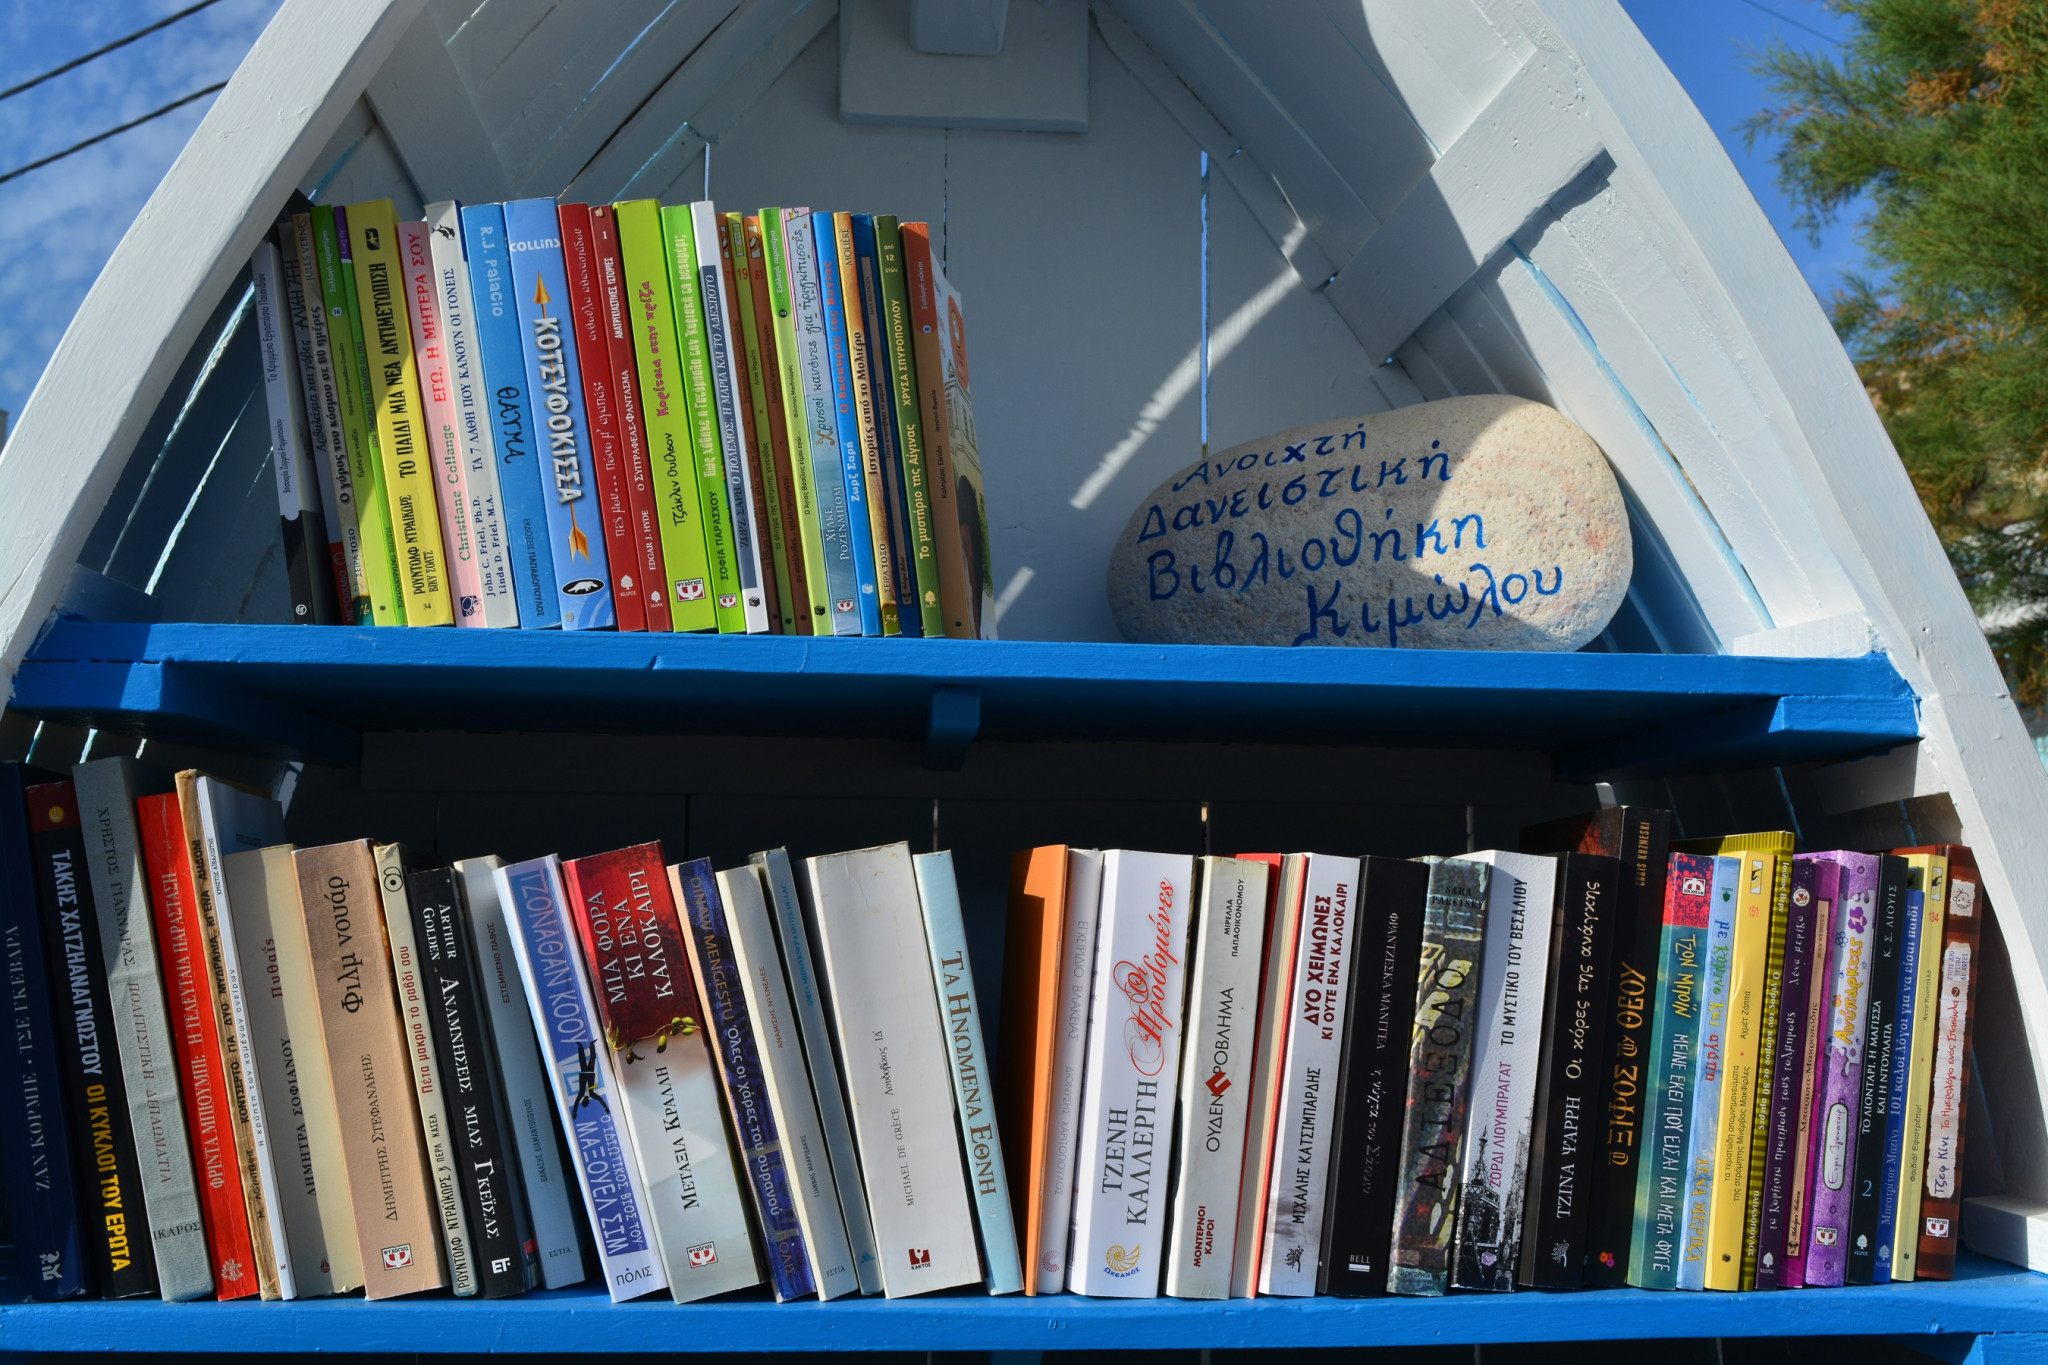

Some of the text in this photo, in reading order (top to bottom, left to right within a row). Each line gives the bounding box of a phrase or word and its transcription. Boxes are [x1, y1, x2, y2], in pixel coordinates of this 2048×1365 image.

[296, 222, 315, 280] JULES VERNE
[444, 268, 459, 309] ΓΟΝΕΙΣ
[369, 262, 416, 478] ΤΟ ΠΑΙΔΙ ΜΙΑ ΝΕΑ ΑΝΤΙΜΕΤΩΠΙΣΗ
[408, 233, 446, 402] ΕΓΩ, Η ΜΗΤΕΡΑ ΣΟΥ
[450, 313, 461, 326] ΟΙ
[453, 330, 469, 377] ΚΑΝΟΥΝ
[639, 281, 670, 416] Κορίτσια στην πρίζα
[891, 299, 911, 405] ΧΡΥΣΑ ΣΠΥΡΟΠΟΥΛΟΥ
[311, 306, 350, 503] Ο γύρος του κόσμου σε 80 ημέρες
[460, 384, 473, 407] ΠΟΥ
[465, 411, 479, 442] ΛΑΘΗ
[533, 316, 582, 503] ΚΟΤΣΥΦΟΚΙΣΣΑ
[703, 273, 742, 486] Ο ΠΟΛΕΜΟΣ. Η ΜΑΡΙΑ ΚΑΙ ΤΟ ΑΔΕΣΠΟΤΟ
[855, 330, 880, 476] Ιστορίες από το Μολιέρο
[443, 424, 470, 561] Christiane Collange
[472, 457, 482, 471] ΤΑ
[663, 432, 687, 526] Τζάκλιν Ουίλσον
[906, 424, 930, 559] Το μυστήριο της Αίγινας
[1136, 439, 1453, 544] Δανειστική
[1172, 423, 1368, 492] Ανοιχτή
[423, 550, 438, 592] ΒΙΚΥ ΣΟΛΤΣ
[523, 518, 544, 616] ΕΚΔΟΣΕΙΣ ΠΑΠΑΔΟΠΟΥΛΟΣ
[641, 510, 650, 532] HYDE
[646, 542, 656, 570] EDGAR
[709, 491, 728, 580] ΣΟΦΙΑ ΠΑΡΑΣΧΟΥ
[1147, 508, 1487, 601] Βιβλιοθήκη
[1290, 563, 1563, 647] Κιμώλου
[52, 849, 102, 1074] ΤΑΚΗΣ ΧΑΤΖΗΑΝΑΓΝΩΣΤΟΥ
[324, 876, 363, 1013] Φιλμ νουάρ
[422, 907, 439, 959] GOLDEN
[438, 904, 456, 958] ARTHUR
[520, 868, 588, 1044] ΤΖΟΝΑΘΑΝ ΚΟΟΥ
[587, 890, 627, 1003] ΜΙΑ ΦΟΡΑ
[613, 898, 645, 979] ΚΙ ΕΝΑ
[628, 869, 674, 999] ΚΑΛΟΚΑΙΡΙ
[1224, 899, 1233, 935] ΜΙΡΕΛΛΑ
[1232, 879, 1244, 957] ΠΑΠΑΟΙΚΟΝΟΜΟΥ
[1304, 895, 1330, 1025] ΔΥΟ ΧΕΙΜΩΝΕΣ
[1321, 883, 1347, 1039] ΚΙ ΟΥΤΕ ΕΝΑ ΚΑΛΟΚΑΙΡΙ
[1501, 878, 1526, 1044] ΤΟ ΜΥΣΤΙΚΟ ΤΟΥ ΒΕΣΑΛΙΟΥ
[1883, 885, 1897, 957] Κ. Σ. ΛΙΟΥΙΣ
[400, 946, 432, 1093] Πέτα μακριά τό ραβδί σου
[1565, 881, 1600, 1078] Οι κόρες της ανάγκης
[5, 925, 50, 1190] ΖΑΝ ΚΟΡΜΙΕ ΤΣΕ ΓΚΕΒΑΡΑ
[440, 977, 481, 1147] ΑΝΑΜΝΗΣΕΙΣ ΜΙΑΣ
[1861, 1000, 1881, 1133] ΤΟ ΛΙΟΝΤΑΡΙ, Η ΜΑΓΙΣΣΑ
[1877, 1023, 1892, 1114] ΚΑΙ Η ΝΤΟΥΛΑΠΑ
[86, 1084, 130, 1271] ΟΙ ΚΥΚΛΟΙ ΤΟΥ ΕΡΩΤΑ
[361, 1054, 397, 1220] ΔΗΜΗΤΡΗΣ ΣΤΕΦΑΝΑΚΗΣ
[575, 1121, 628, 1253] ΜΑΞΟΥΕΛ ΣΙΜ
[603, 1113, 643, 1242] Ο ΙΔΙΩΤΙΚΟΣ ΒΙΟΣ ΤΟΥ
[654, 1065, 699, 1210] ΜΕΤΑΞΙΑ ΚΡΑΛΛΗ
[896, 1144, 905, 1157] DE
[900, 1162, 914, 1205] MICHAEL
[1101, 1108, 1127, 1193] ΤΖΕΝΗ
[1126, 1079, 1157, 1224] ΚΑΛΛΕΡΓΗ
[1291, 1067, 1320, 1224] ΜΙΧΑΛΗΣ ΚΑΤΣΙΜΠΑΡΔΗΣ
[1556, 1096, 1580, 1217] ΤΖΙΝΑ ΨΑΡΡΗ
[153, 1222, 200, 1240] ΙΚΑΡΟΣ
[1194, 1206, 1206, 1267] ΜΟΝΤΕΡΝΟΙ
[1205, 1219, 1214, 1254] ΚΑΙΡΟΙ
[1350, 1254, 1370, 1263] BELL
